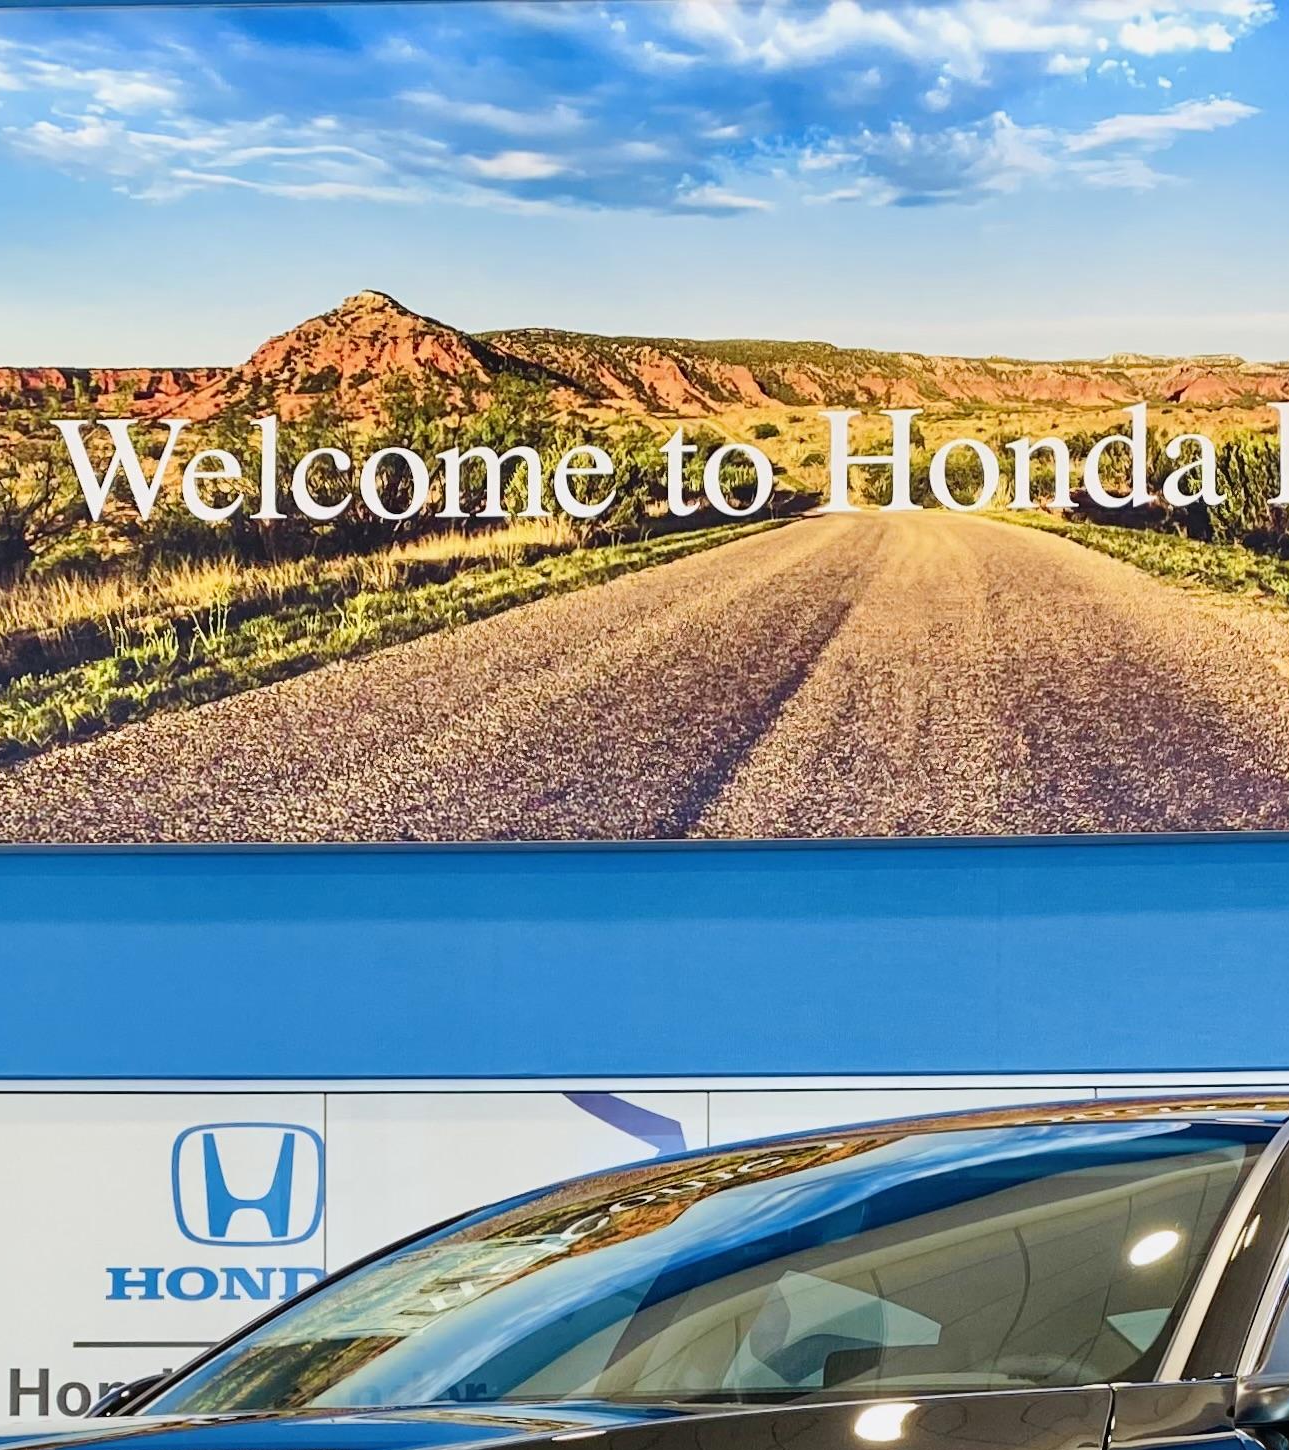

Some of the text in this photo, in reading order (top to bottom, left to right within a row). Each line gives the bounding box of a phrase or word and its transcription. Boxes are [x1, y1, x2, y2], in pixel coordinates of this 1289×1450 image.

[49, 414, 617, 523] Welcome
[659, 427, 773, 516] to
[816, 402, 1228, 513] Honda
[105, 1267, 329, 1301] HOND
